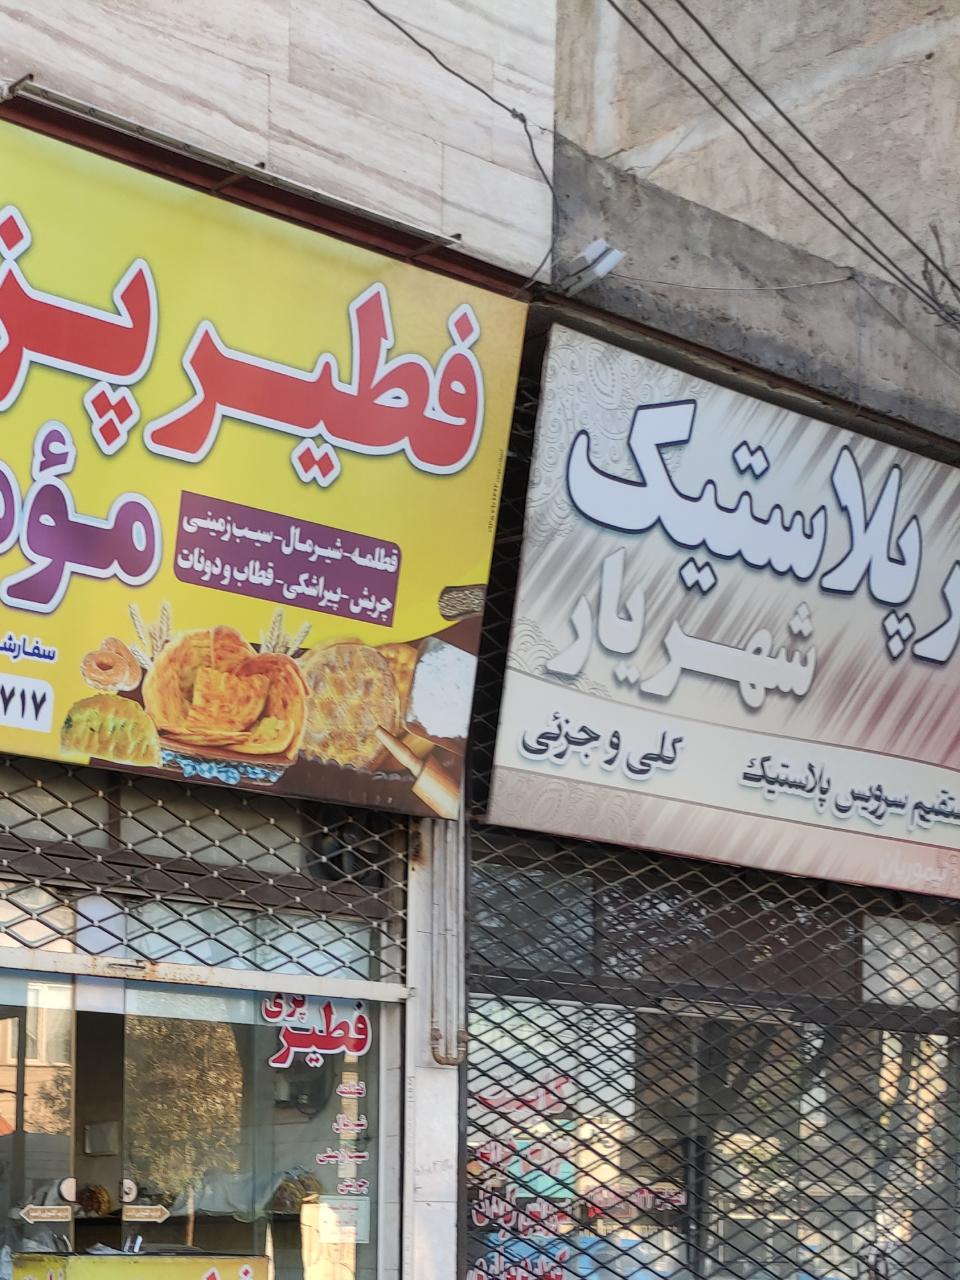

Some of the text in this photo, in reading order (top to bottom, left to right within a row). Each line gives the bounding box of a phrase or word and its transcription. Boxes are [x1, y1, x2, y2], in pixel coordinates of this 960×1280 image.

[144, 282, 484, 488] فطیر
[567, 399, 922, 661] پلاستیک
[177, 547, 222, 581] دونات
[233, 561, 274, 588] قطاب
[547, 547, 817, 714] شهریار
[522, 711, 684, 776] کلی و جزئی
[742, 755, 831, 808] پلاستیک
[834, 784, 908, 820] سرویس
[268, 1000, 372, 1068] فطیر
